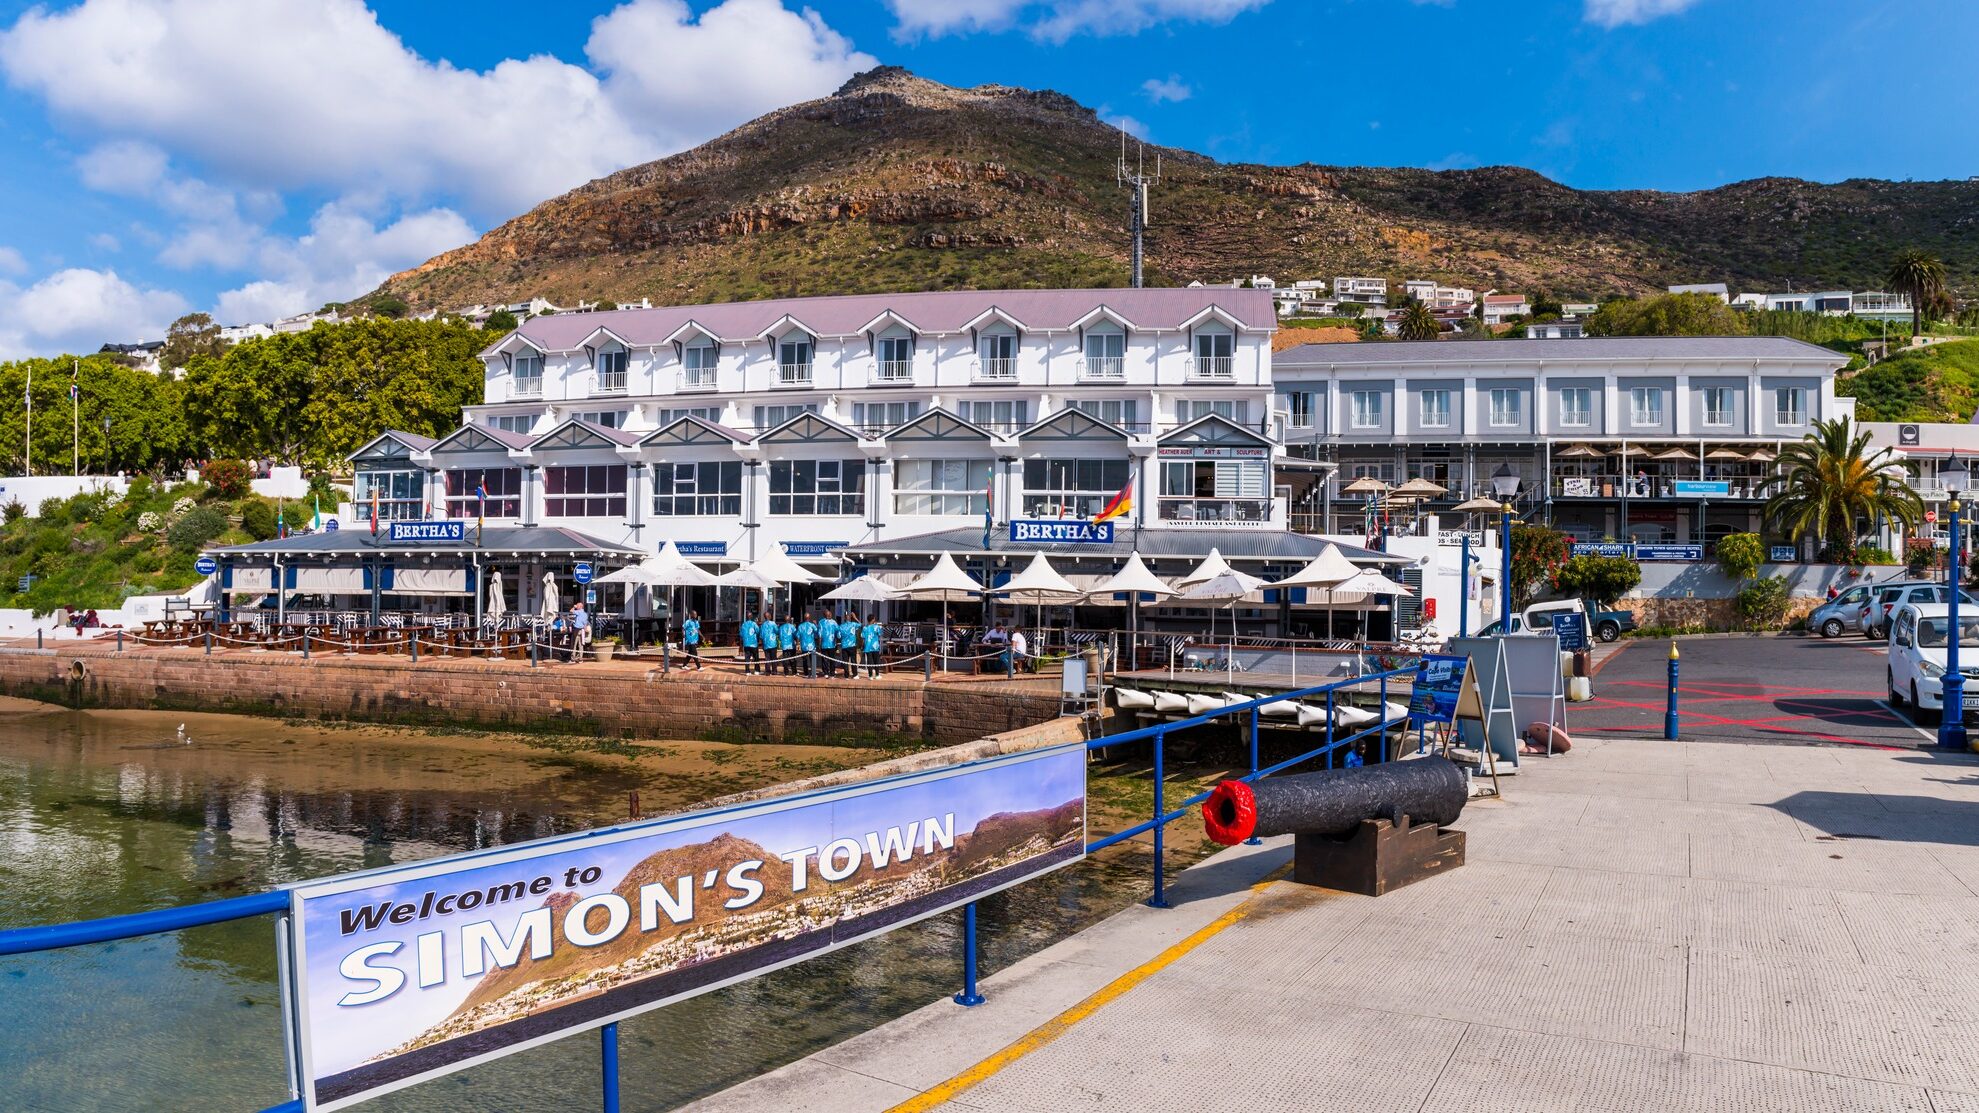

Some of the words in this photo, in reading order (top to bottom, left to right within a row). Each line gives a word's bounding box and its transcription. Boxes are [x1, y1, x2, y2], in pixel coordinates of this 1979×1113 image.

[394, 524, 460, 539] BERTHA'S
[1015, 522, 1108, 541] BERTHA'S
[693, 545, 724, 553] Restaurant
[790, 545, 825, 553] WATERFRONT
[339, 875, 552, 936] Welcome
[563, 864, 602, 888] to
[336, 859, 766, 1007] SIMON'S
[781, 812, 956, 893] TOWN
